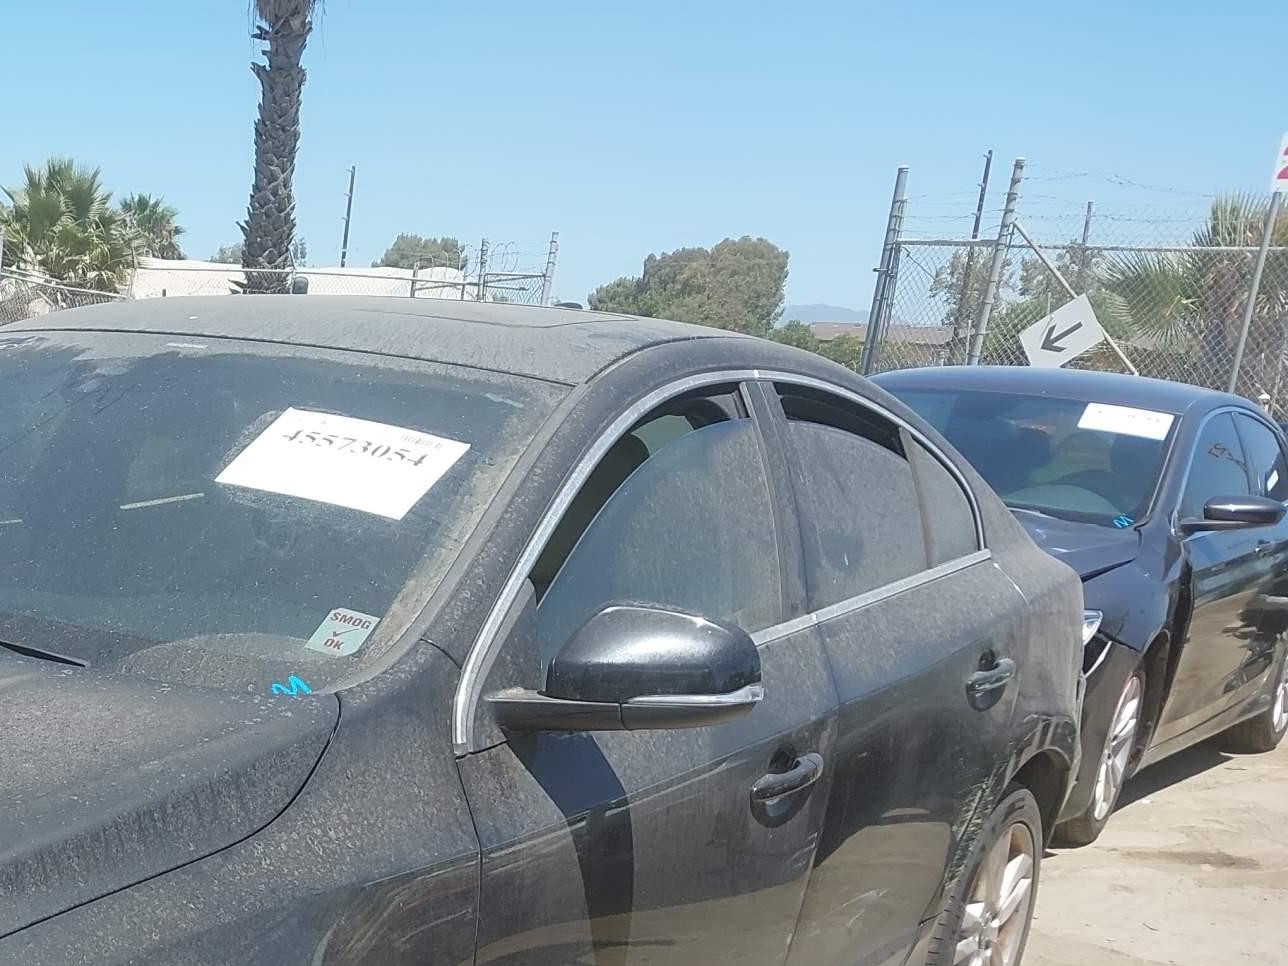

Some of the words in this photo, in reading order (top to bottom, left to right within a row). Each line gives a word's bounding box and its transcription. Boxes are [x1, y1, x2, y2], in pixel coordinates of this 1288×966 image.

[282, 429, 428, 467] 45573054
[330, 612, 372, 630] SMOG
[323, 638, 345, 650] OK
